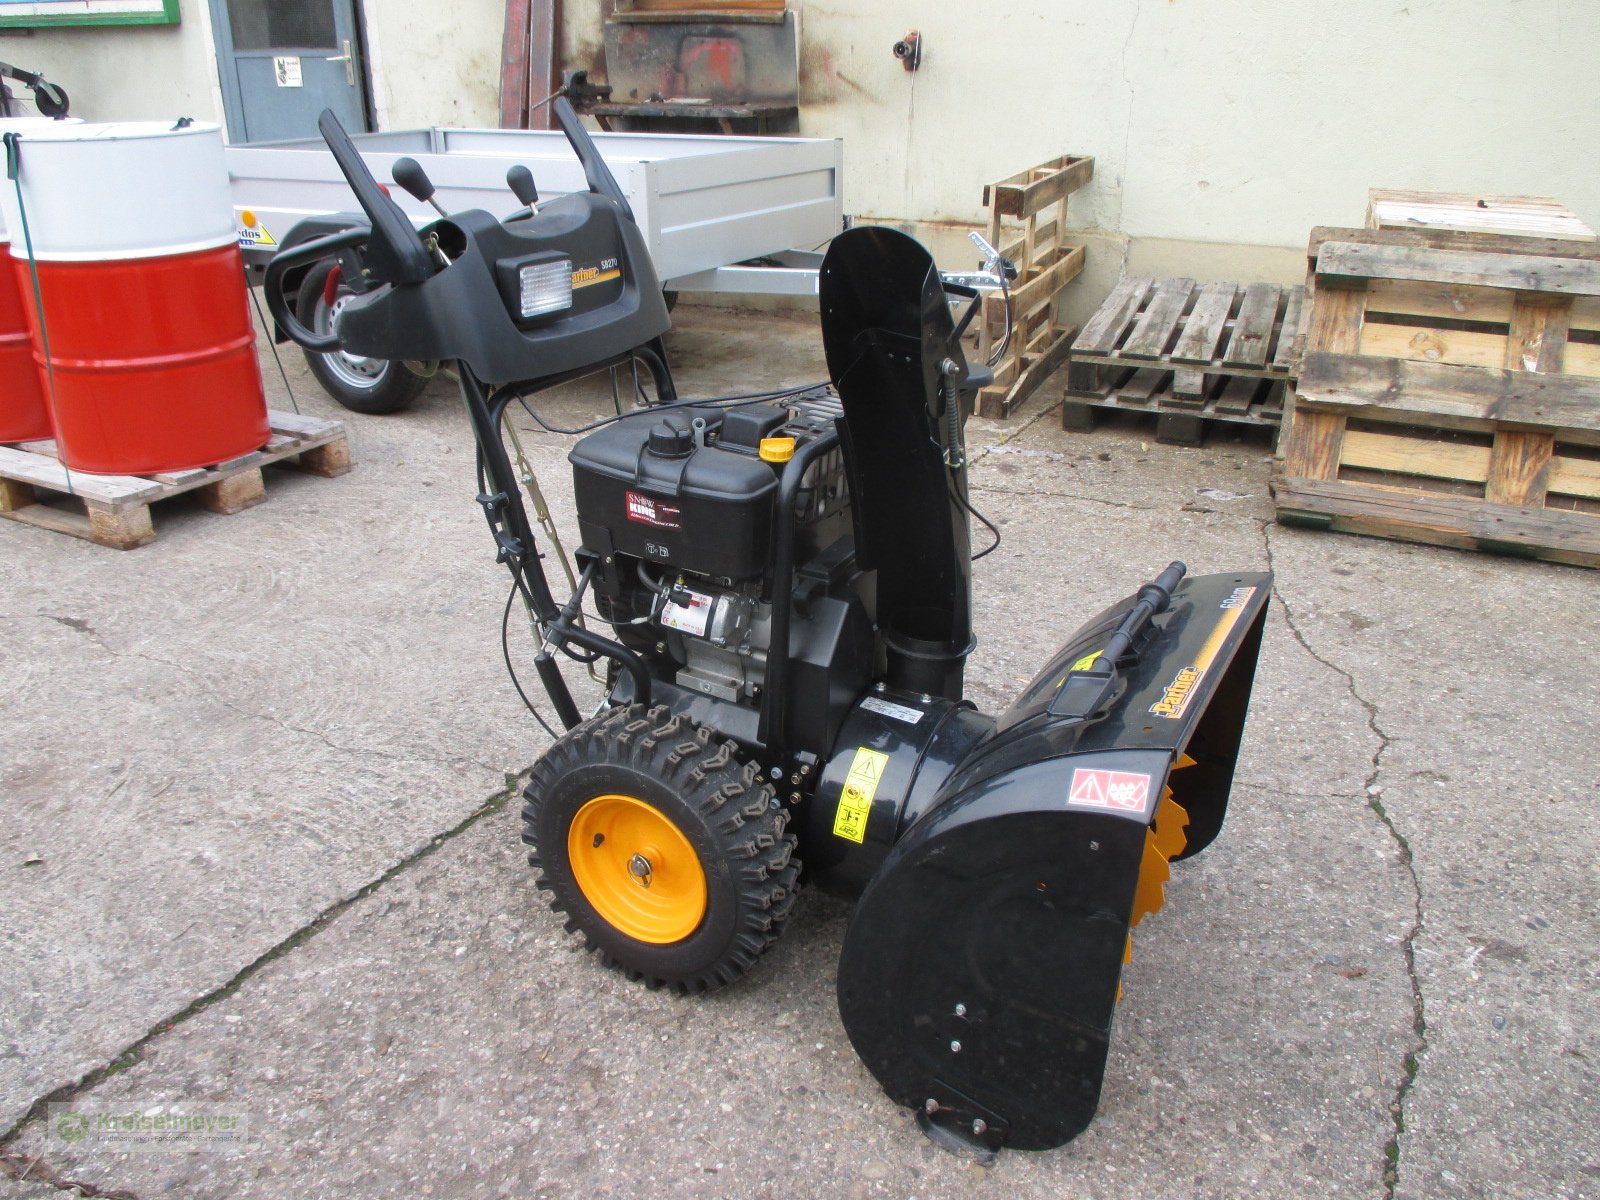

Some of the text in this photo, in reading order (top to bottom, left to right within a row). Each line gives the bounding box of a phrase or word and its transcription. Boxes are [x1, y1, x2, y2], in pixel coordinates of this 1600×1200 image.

[571, 267, 599, 283] artner
[629, 502, 656, 519] KING
[1220, 586, 1251, 609] 69cm
[1149, 667, 1202, 716] Partner
